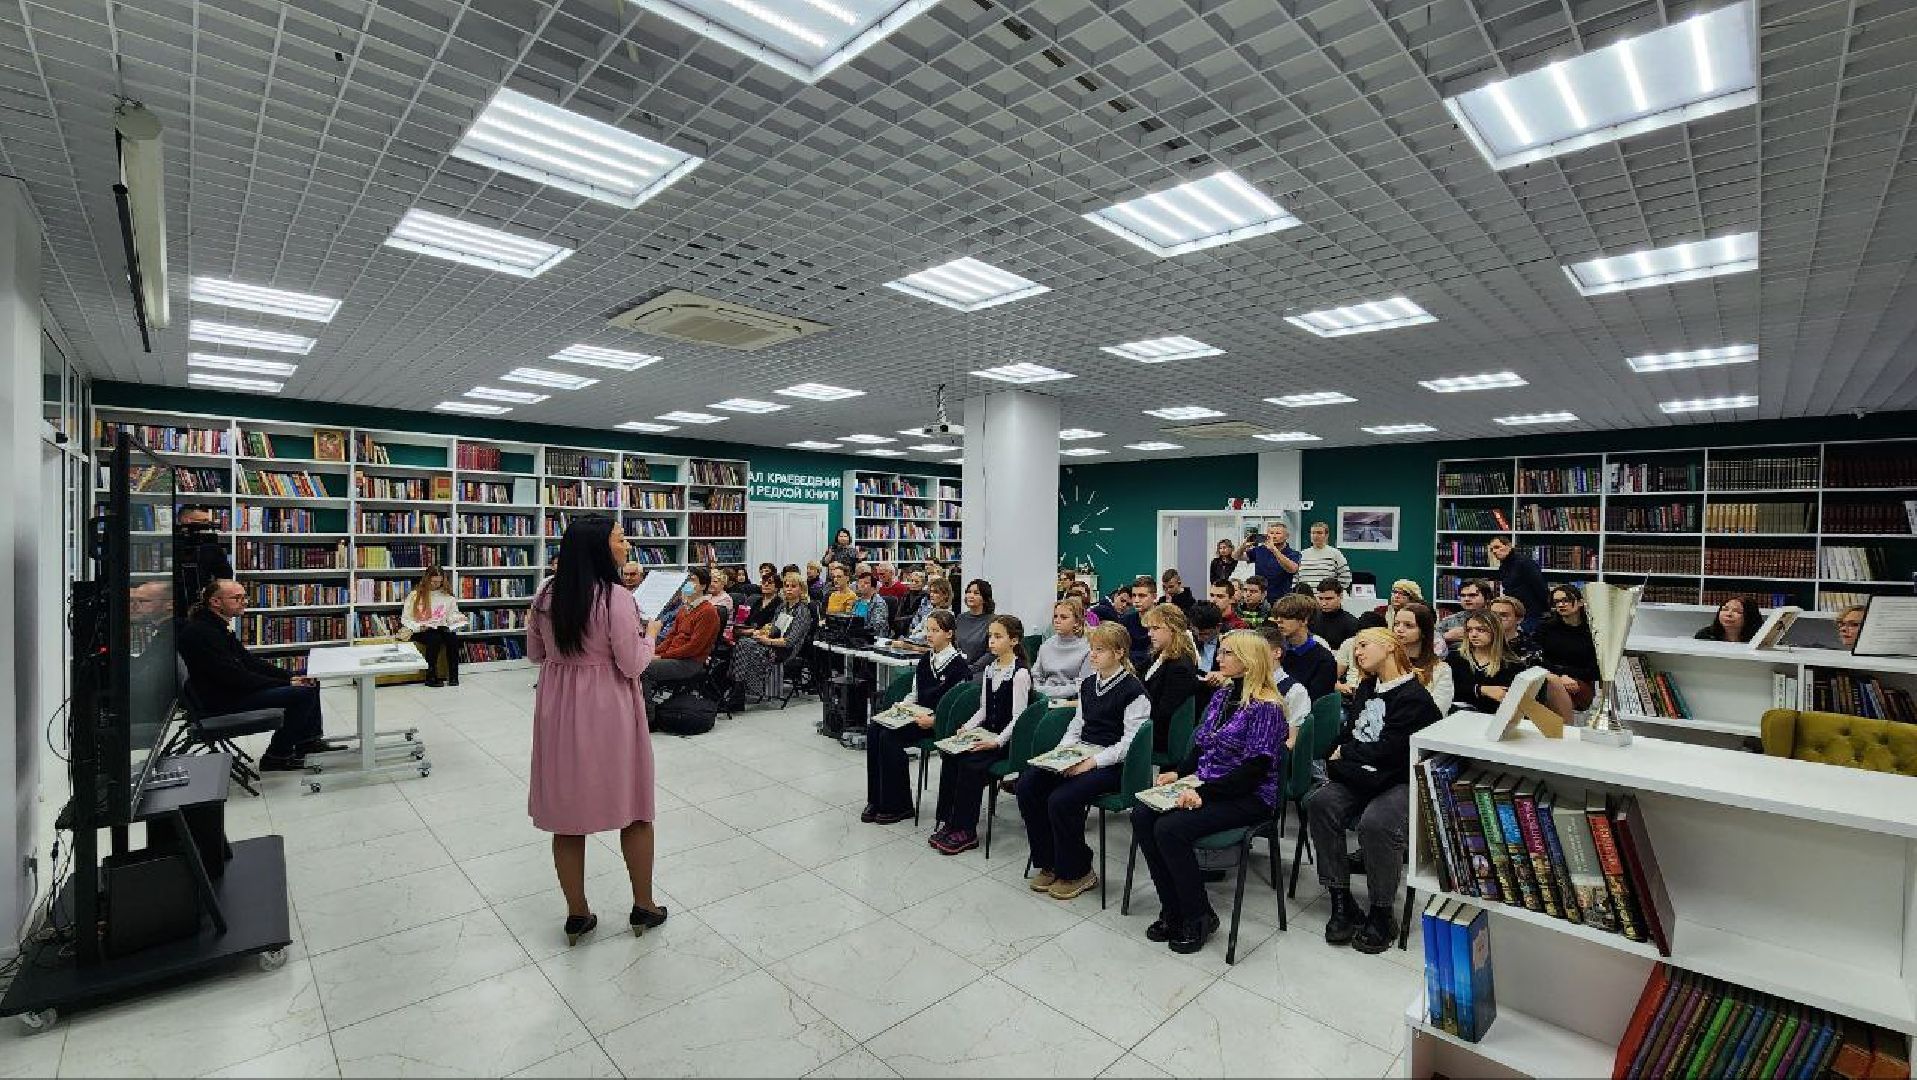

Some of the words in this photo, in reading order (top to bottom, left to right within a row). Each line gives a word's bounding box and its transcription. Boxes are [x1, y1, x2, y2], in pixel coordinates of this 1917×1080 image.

[767, 472, 841, 488] КРАЕВЕДЕНИЯ
[757, 485, 801, 499] РЕДКОЙ
[805, 488, 838, 501] КНИГИ
